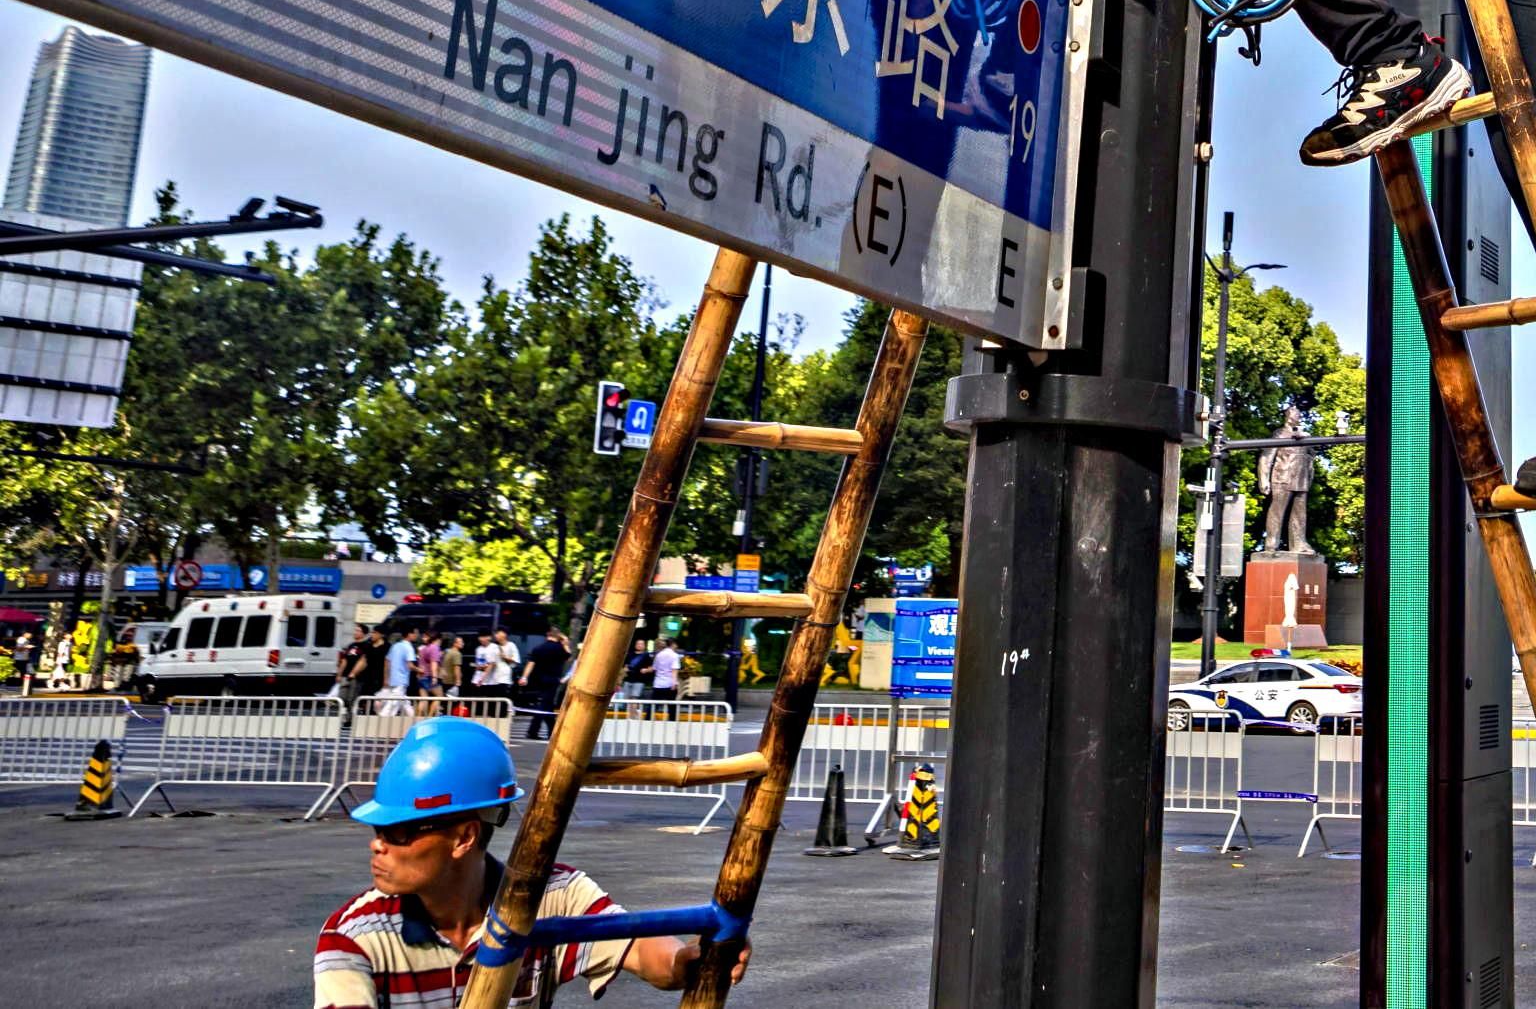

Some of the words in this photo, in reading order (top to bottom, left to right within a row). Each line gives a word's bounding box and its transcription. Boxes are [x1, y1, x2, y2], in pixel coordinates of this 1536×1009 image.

[1008, 94, 1036, 164] 19
[852, 161, 907, 266] (E)
[998, 238, 1019, 309] E
[1255, 689, 1278, 701] 公安
